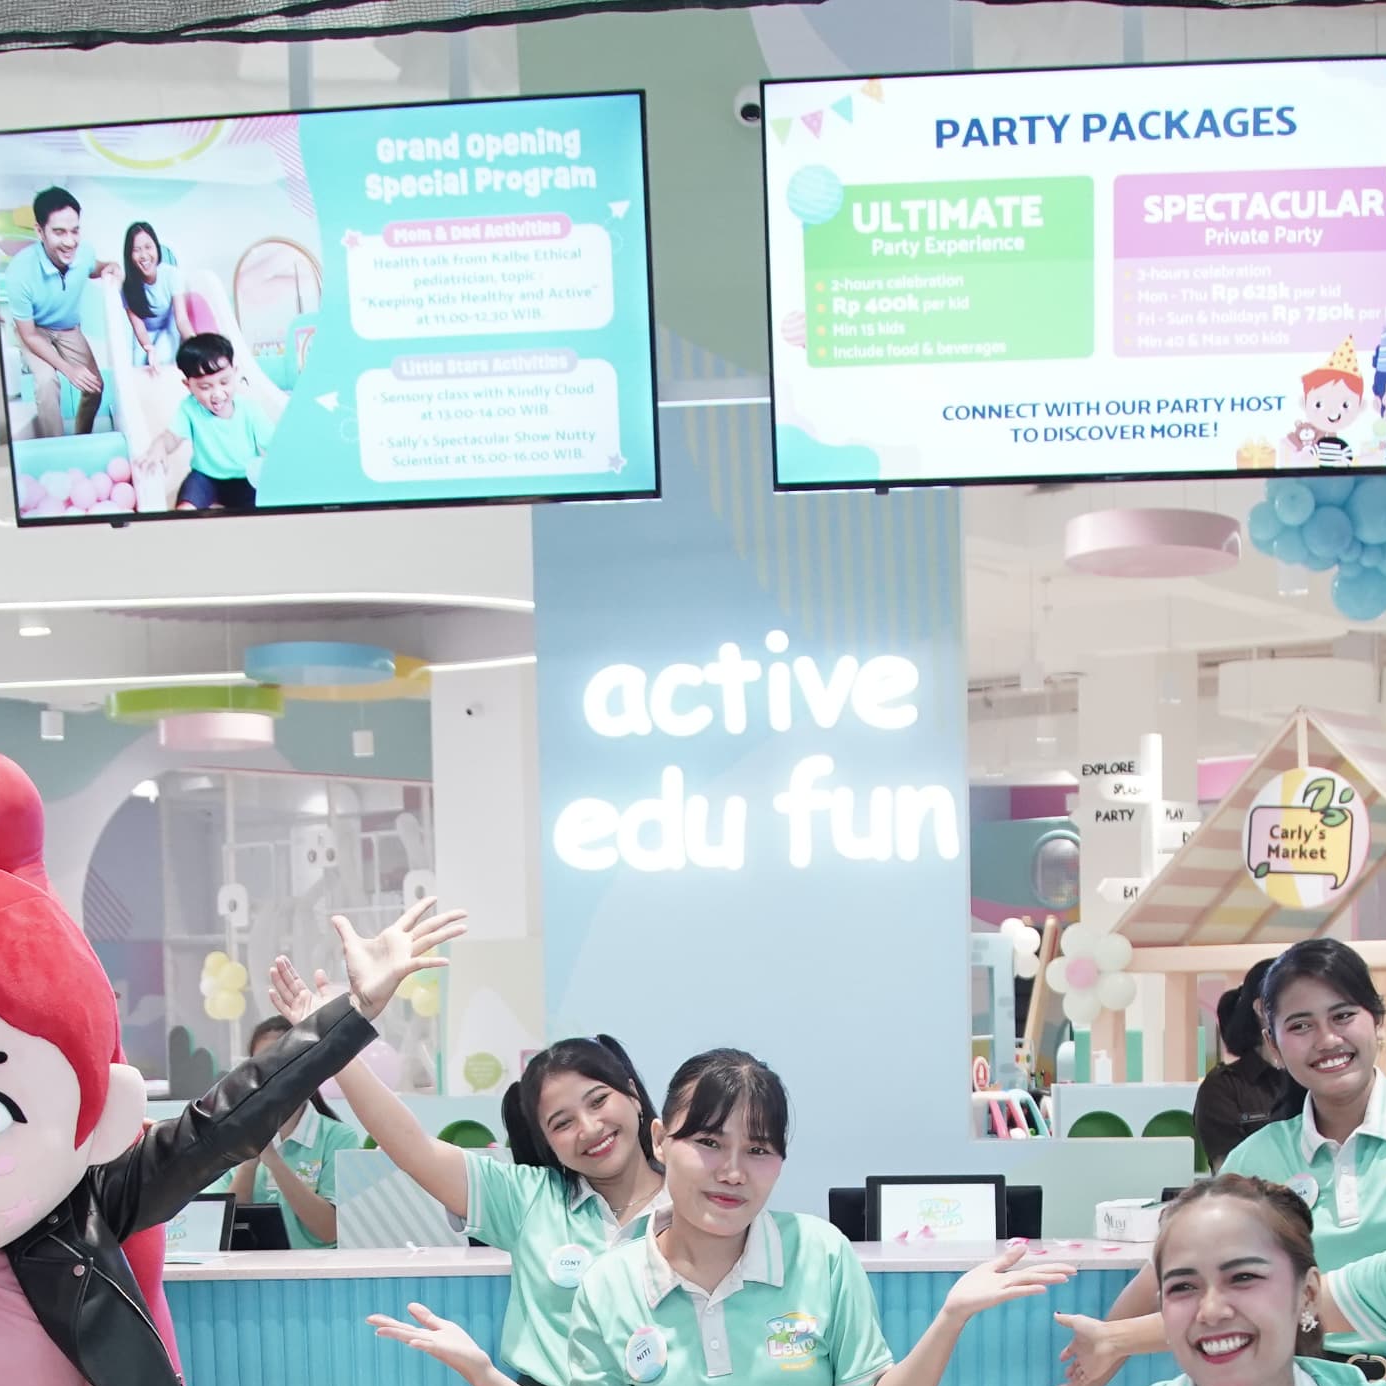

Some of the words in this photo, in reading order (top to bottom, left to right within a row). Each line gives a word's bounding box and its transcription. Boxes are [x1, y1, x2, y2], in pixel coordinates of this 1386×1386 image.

[935, 114, 1070, 149] PARTY
[1083, 106, 1298, 142] PACKAGES
[377, 131, 460, 164] Grand
[466, 127, 581, 162] Opening
[365, 167, 469, 204] Special
[475, 165, 597, 197] Program
[852, 195, 1044, 234] ULTIMATE
[1143, 188, 1385, 223] SPECTACULAR
[394, 228, 431, 243] Mom
[435, 226, 448, 241] &
[451, 224, 481, 240] Dad
[485, 220, 561, 238] Activities
[1205, 227, 1269, 246] Private
[1275, 225, 1323, 246] Party
[872, 238, 920, 258] Party
[925, 235, 1025, 257] Experience
[373, 256, 419, 270] Health
[423, 254, 449, 267] talk
[453, 252, 487, 266] from
[492, 250, 529, 265] Kalbe
[535, 248, 582, 261] Ethical
[414, 272, 497, 289] pediatrician,
[501, 269, 535, 285] topic
[831, 278, 883, 293] 2-hours
[886, 274, 964, 290] celebration
[1137, 267, 1190, 283] 3-hours
[1193, 264, 1272, 280] celebration
[428, 289, 457, 306] Kids
[461, 286, 513, 308] Healthy
[520, 287, 544, 301] and
[1137, 290, 1168, 304] Mon
[1181, 288, 1207, 302] Thu
[1212, 284, 1239, 305] Rp
[1242, 282, 1290, 301] 625k
[1294, 287, 1317, 301] per
[1320, 284, 1341, 297] kid
[832, 297, 860, 318] Rp
[864, 294, 919, 314] 400k
[923, 299, 945, 315] per
[949, 296, 970, 311] kid
[1137, 312, 1155, 326] Fri
[1166, 311, 1193, 325] Sun
[1211, 307, 1269, 327] holidays
[1272, 305, 1300, 326] Rp
[1305, 303, 1354, 322] 750k
[1358, 307, 1381, 322] per
[416, 316, 430, 326] at
[832, 322, 857, 337] Min
[861, 323, 874, 337] 15
[878, 321, 905, 336] kids
[1262, 330, 1290, 346] kids
[833, 344, 883, 360] Include
[887, 342, 919, 358] food
[922, 343, 933, 356] &
[936, 341, 1007, 359] beverages
[402, 359, 443, 377] Little
[492, 354, 568, 373] Activities
[380, 391, 433, 405] Sensory
[438, 389, 470, 402] class
[474, 387, 503, 400] with
[508, 384, 551, 399] Kindly
[555, 383, 594, 396] Cloud
[420, 410, 434, 421] at
[942, 403, 1040, 421] CONNECT
[1045, 401, 1100, 418] WITH
[1105, 399, 1151, 416] OUR
[1156, 397, 1225, 414] PARTY
[1231, 395, 1285, 412] HOST
[433, 433, 510, 448] Spectacular
[515, 430, 551, 443] Show
[555, 429, 596, 443] Nutty
[1010, 427, 1039, 443] TO
[1044, 424, 1145, 442] DISCOVER
[392, 453, 450, 468] Scientist
[454, 452, 468, 464] at
[583, 629, 920, 737] active
[1082, 761, 1135, 776] EXPLORE
[553, 765, 748, 872] edu
[773, 754, 960, 868] fun
[1095, 808, 1135, 823] PARTY
[1165, 807, 1185, 820] PLAY
[1269, 824, 1326, 843] Carly's
[1267, 844, 1328, 860] Market
